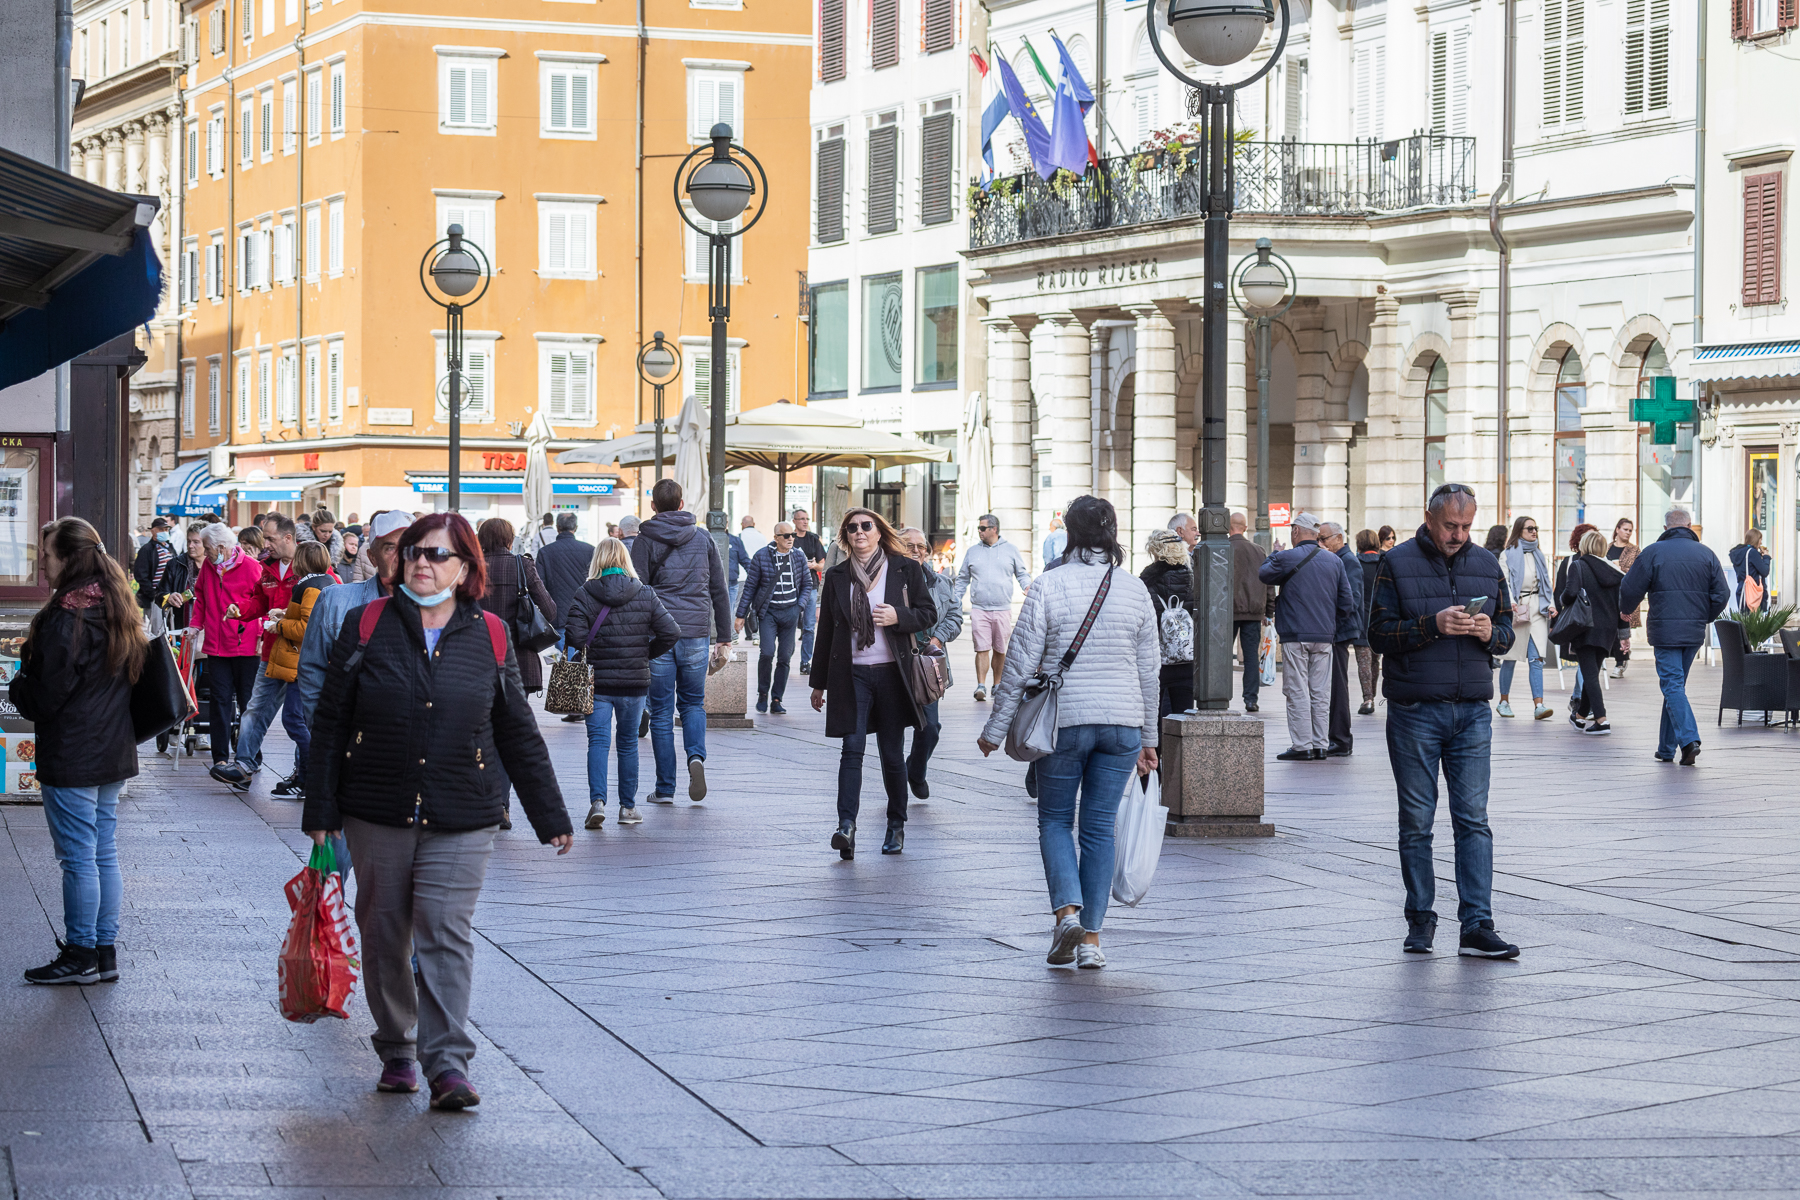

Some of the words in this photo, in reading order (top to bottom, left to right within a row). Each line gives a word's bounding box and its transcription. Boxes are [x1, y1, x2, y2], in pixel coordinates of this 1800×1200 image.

[1037, 267, 1088, 290] RADIO
[1098, 257, 1158, 284] RIJEKA
[418, 484, 444, 492] TISAK
